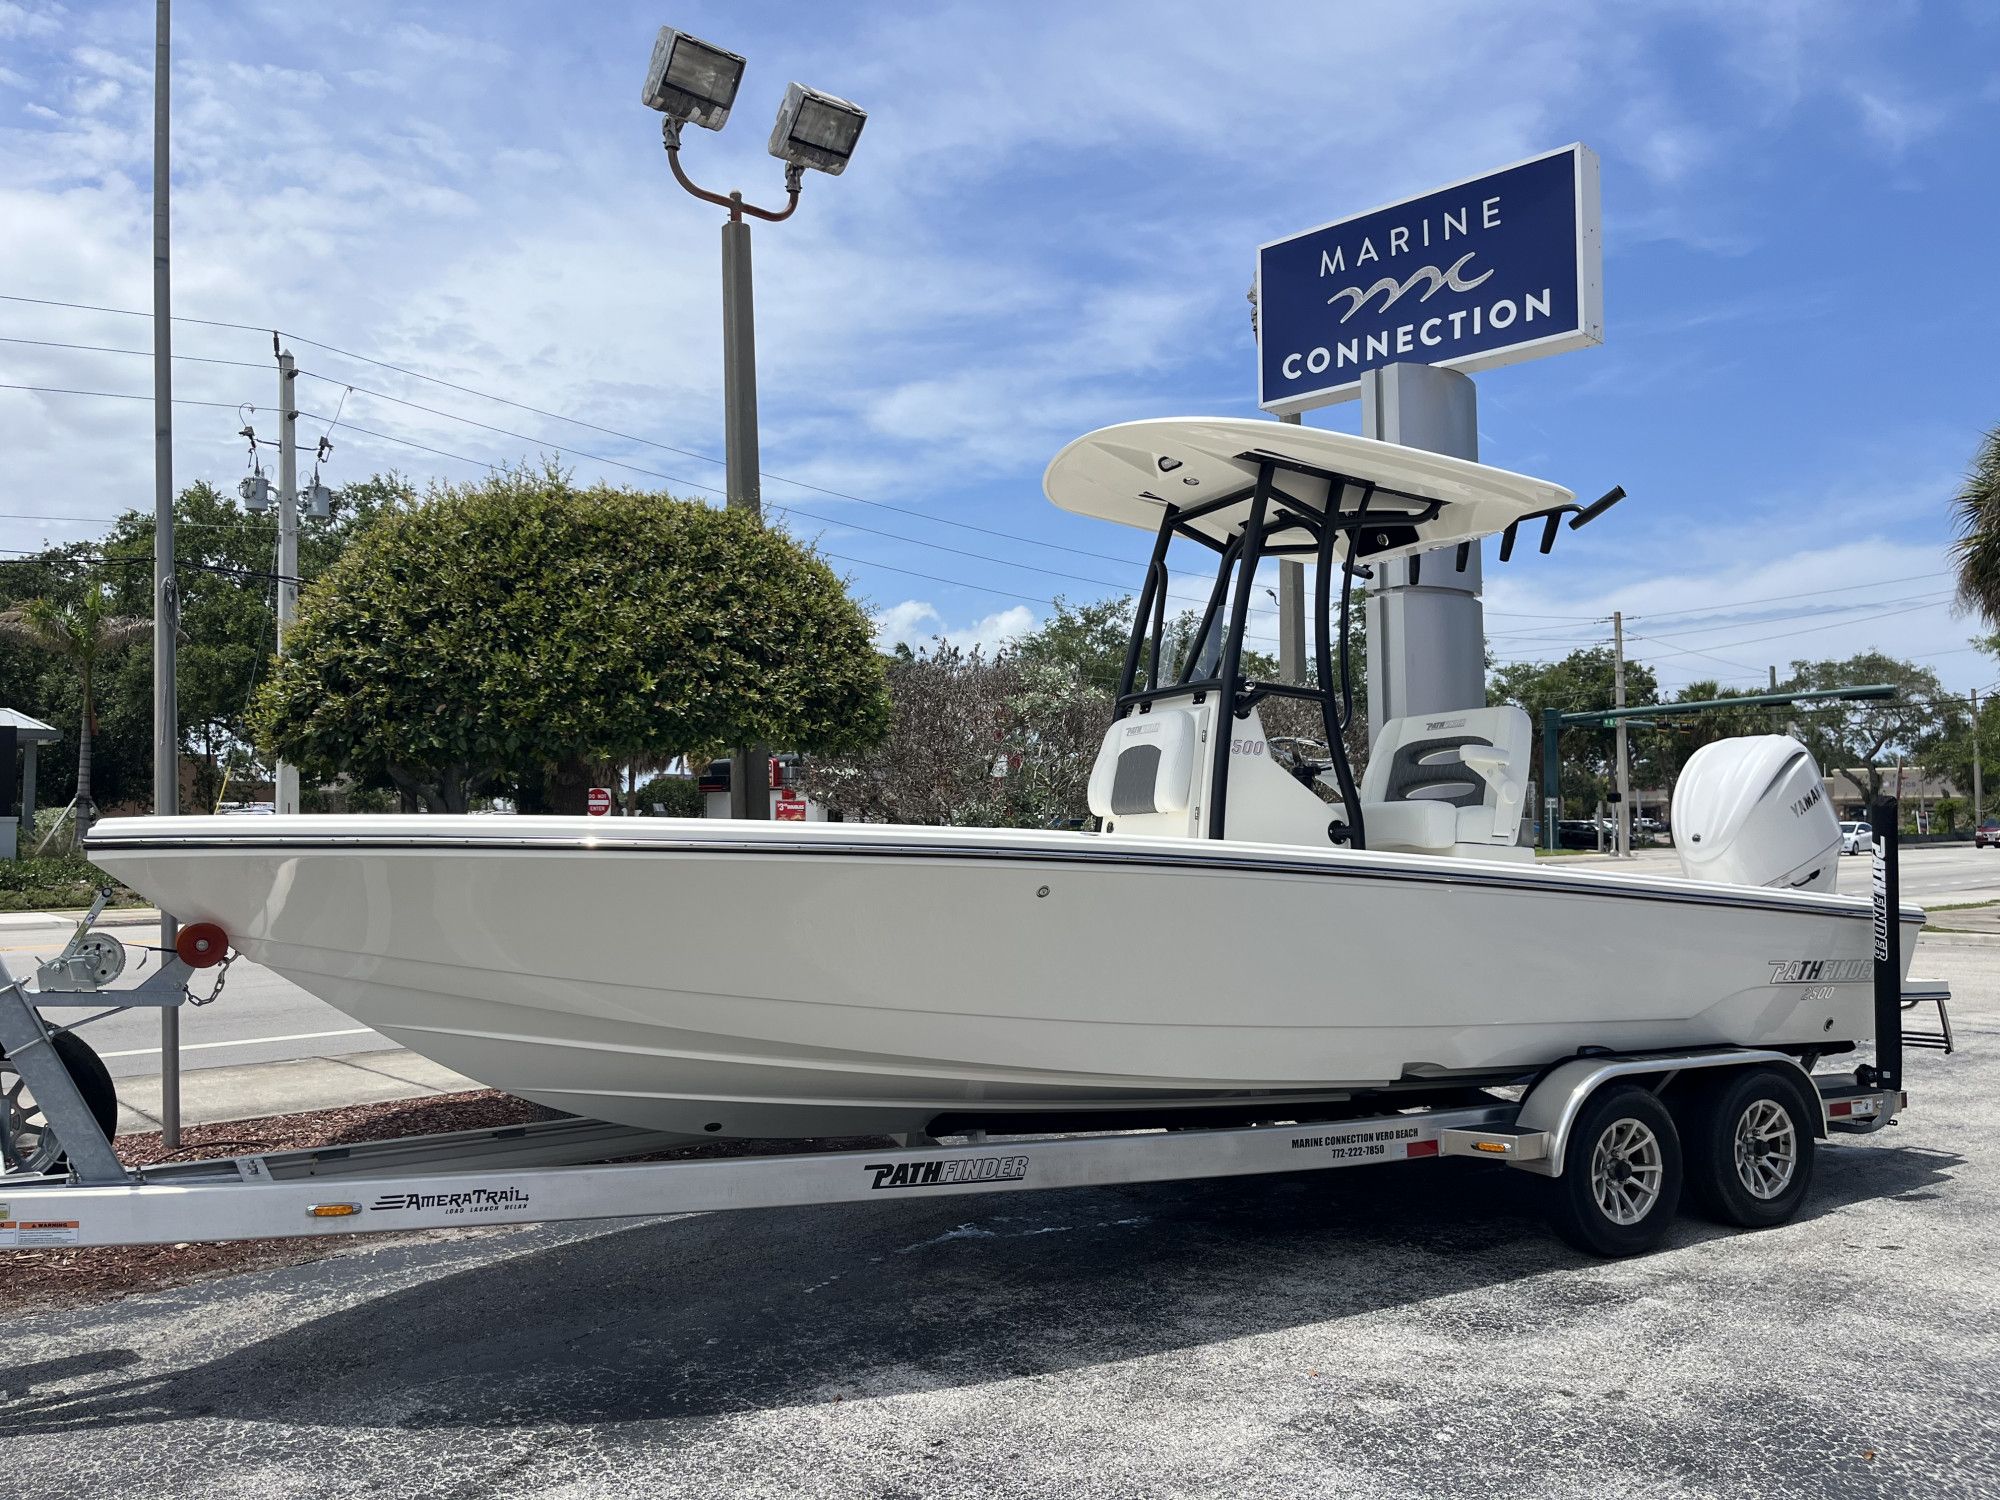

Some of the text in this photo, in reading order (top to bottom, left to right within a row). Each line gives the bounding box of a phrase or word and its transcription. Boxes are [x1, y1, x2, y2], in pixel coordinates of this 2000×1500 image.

[1320, 196, 1501, 277] MARINE
[1282, 288, 1551, 379] CONNECTION
[1231, 739, 1265, 756] 500
[1872, 835, 1888, 961] PATHFINDER
[1768, 960, 1875, 984] PATHFINDE
[1801, 986, 1835, 1000] 2500
[1291, 1128, 1418, 1149] MARINE CONNECTION VERO BEACH
[1332, 1144, 1385, 1158] 772-222-7850
[864, 1156, 1029, 1189] PATHFINDER
